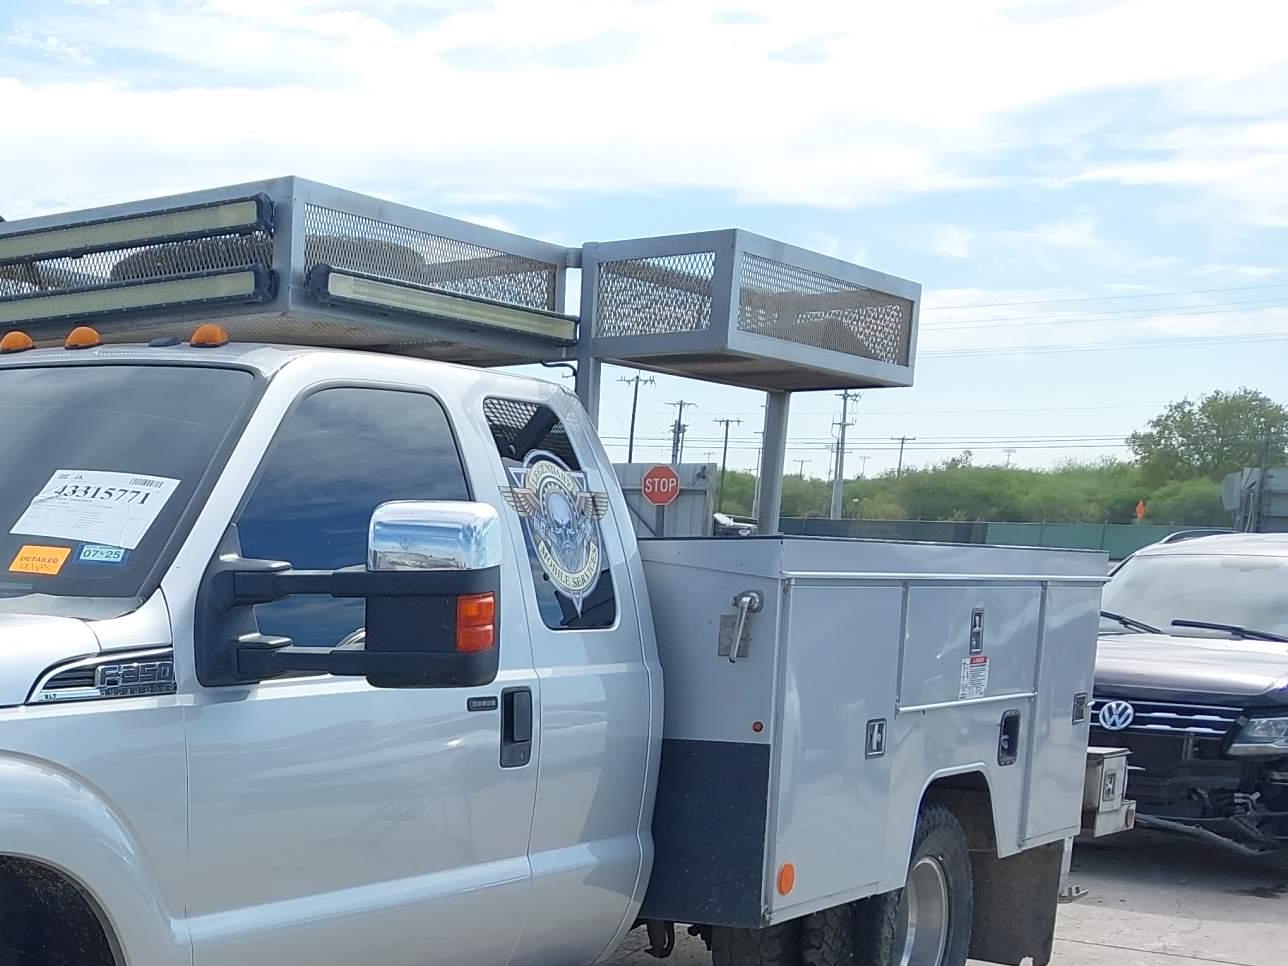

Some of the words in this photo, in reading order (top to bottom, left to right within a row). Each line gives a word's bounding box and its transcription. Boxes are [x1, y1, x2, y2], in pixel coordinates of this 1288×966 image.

[54, 484, 151, 505] 43315771
[644, 478, 677, 493] STOP
[83, 549, 99, 558] 07
[105, 550, 120, 560] 25
[540, 545, 570, 585] MOBILE
[572, 546, 597, 588] SERVICES
